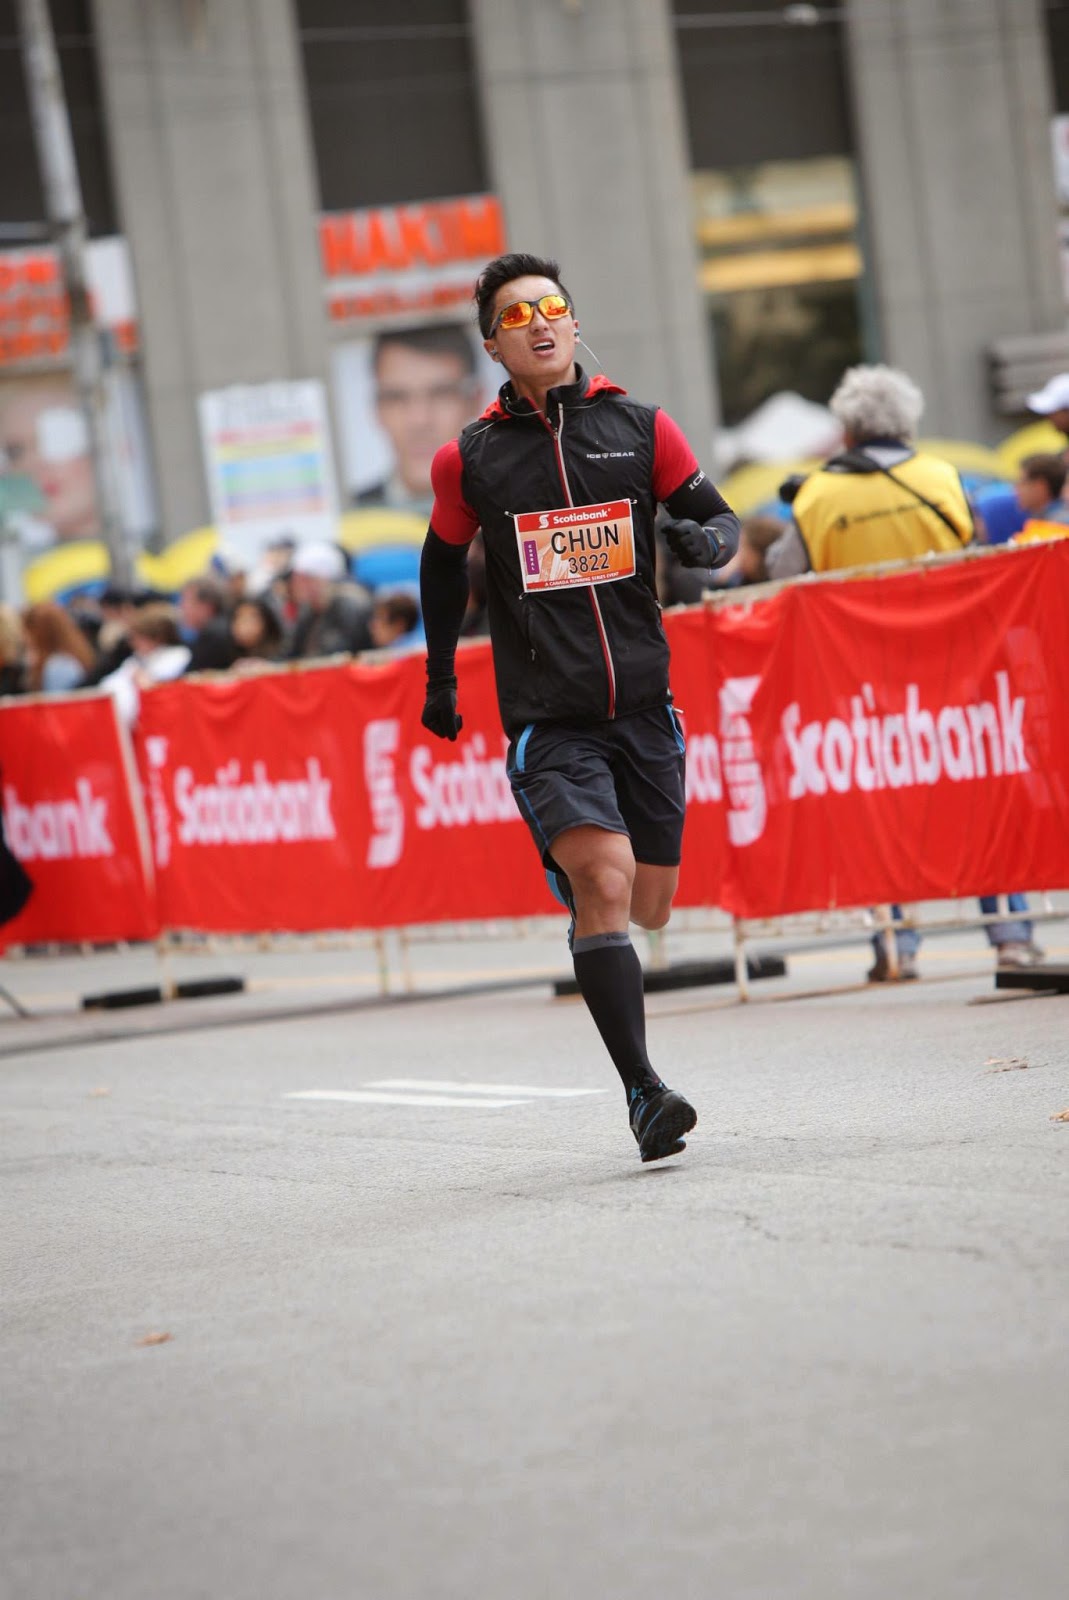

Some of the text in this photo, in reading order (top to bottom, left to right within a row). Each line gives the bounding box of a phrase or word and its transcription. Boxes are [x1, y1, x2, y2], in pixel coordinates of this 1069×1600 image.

[551, 523, 619, 554] CHUN
[553, 509, 608, 524] Scotiabank
[568, 552, 610, 574] 3822
[781, 670, 1031, 800] Scotiabank
[174, 756, 336, 846] Scotiabank
[409, 731, 523, 830] Scotia
